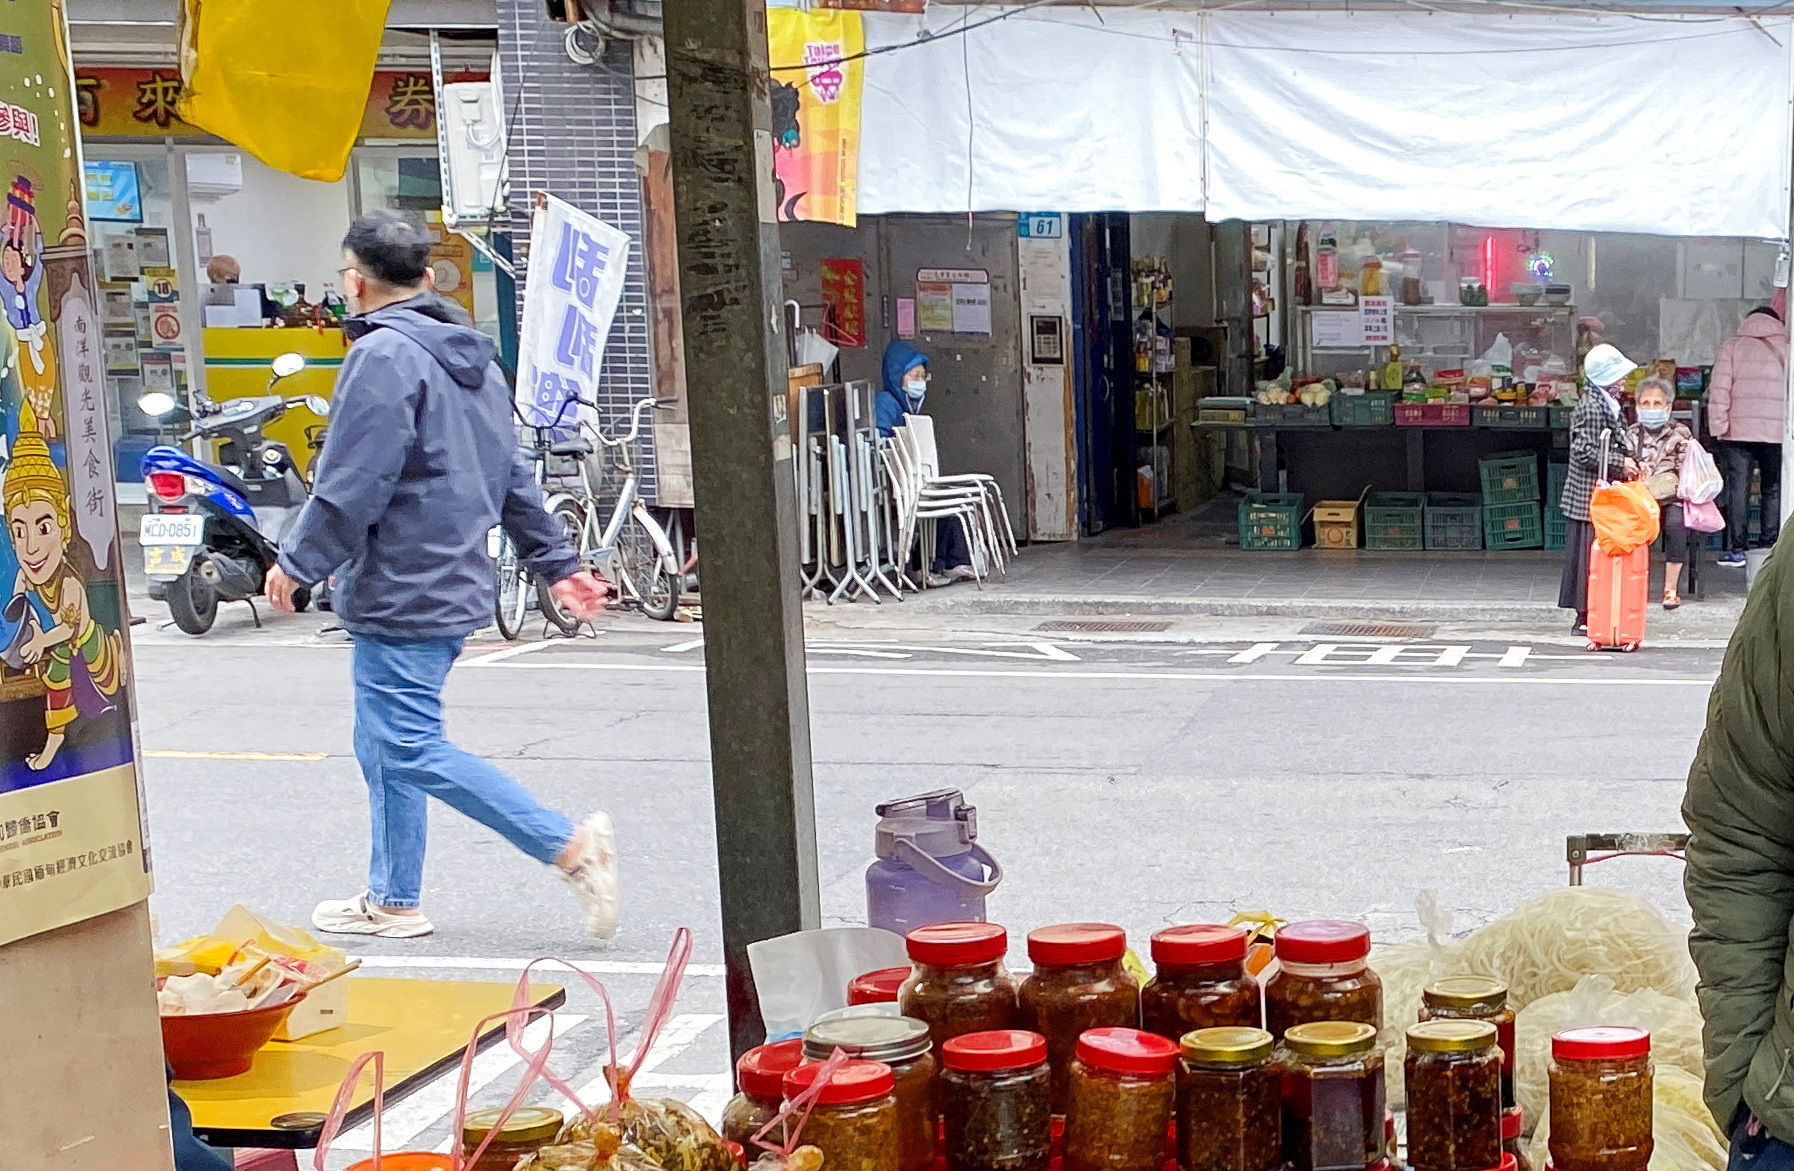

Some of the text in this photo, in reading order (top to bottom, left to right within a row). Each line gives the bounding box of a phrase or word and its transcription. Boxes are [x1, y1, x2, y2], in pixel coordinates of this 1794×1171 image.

[1036, 219, 1053, 235] 61
[156, 282, 170, 295] 18
[74, 315, 104, 518] 南洋觀光美食街
